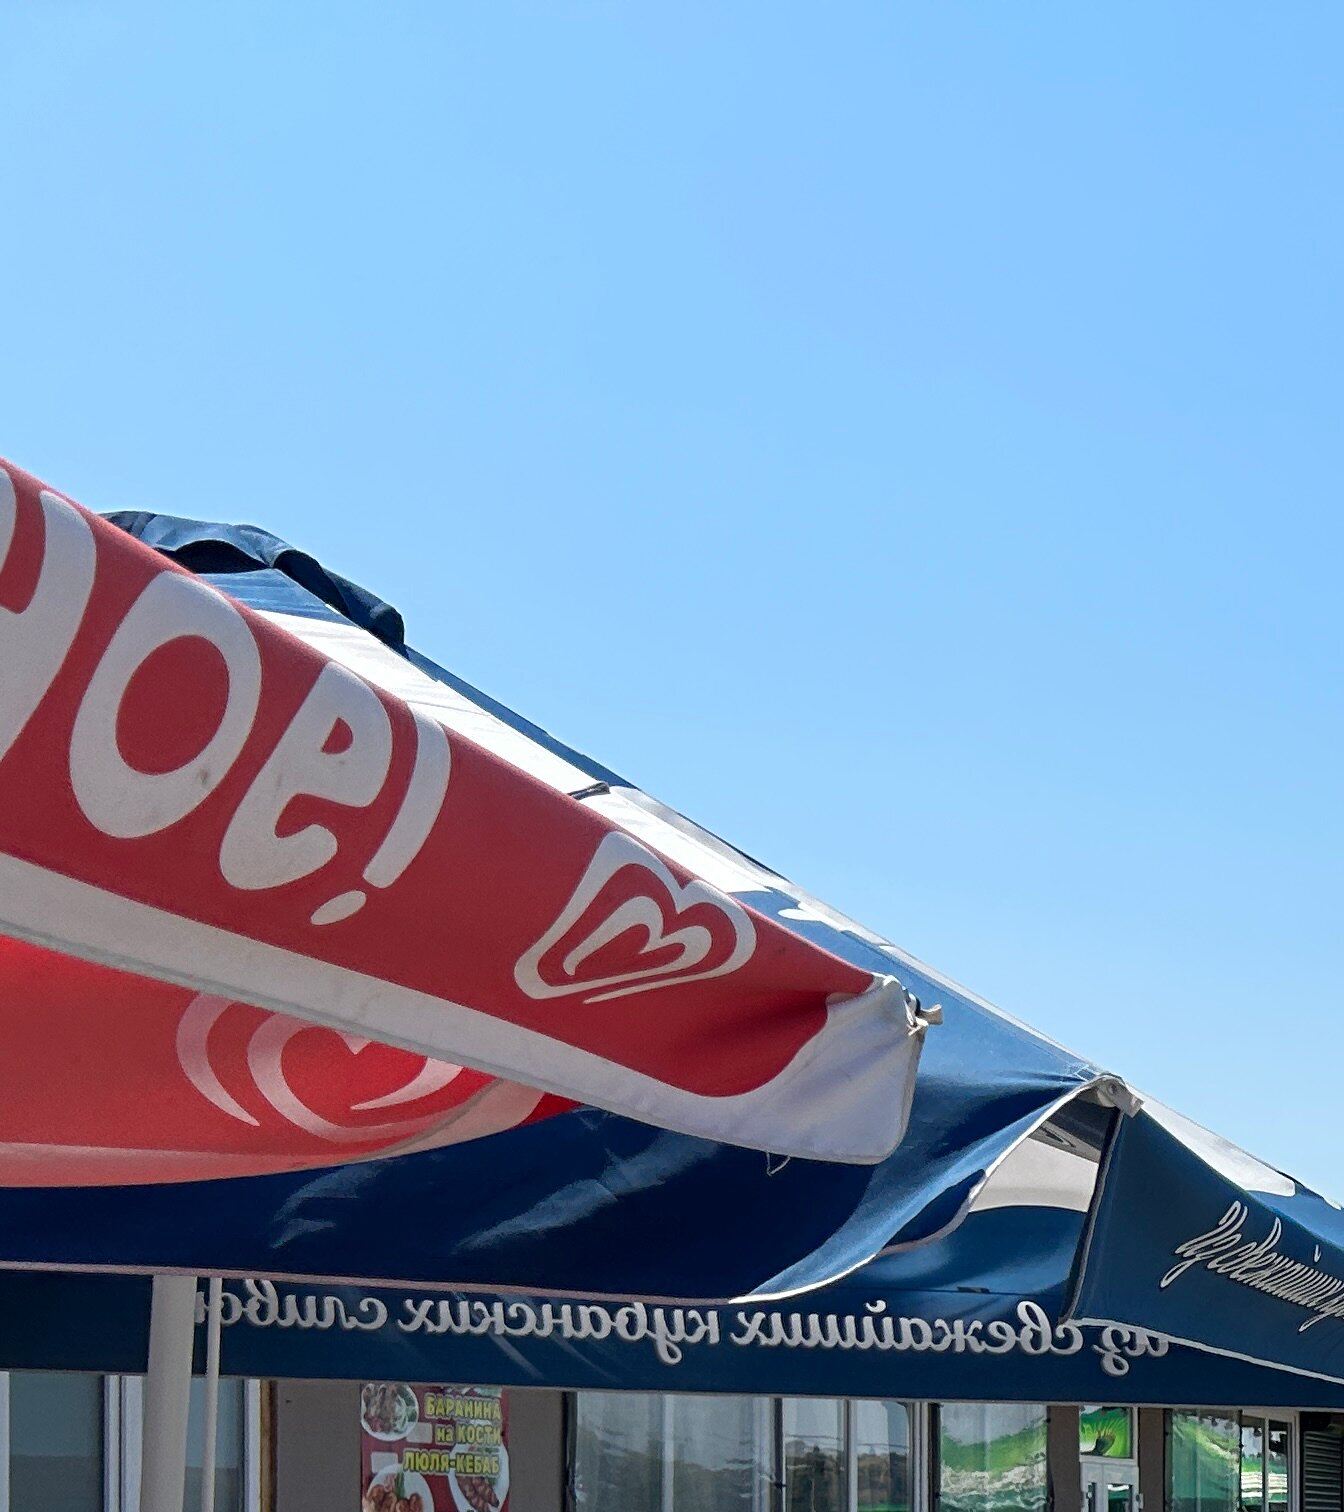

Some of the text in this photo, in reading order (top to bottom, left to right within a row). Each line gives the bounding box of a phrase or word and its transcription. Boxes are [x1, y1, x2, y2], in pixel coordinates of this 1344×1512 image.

[425, 1396, 501, 1419] БАРАНИНА
[457, 1424, 501, 1445] КОСТИ
[403, 1451, 499, 1473] ЛЮЛЯ-КЕБАБ
